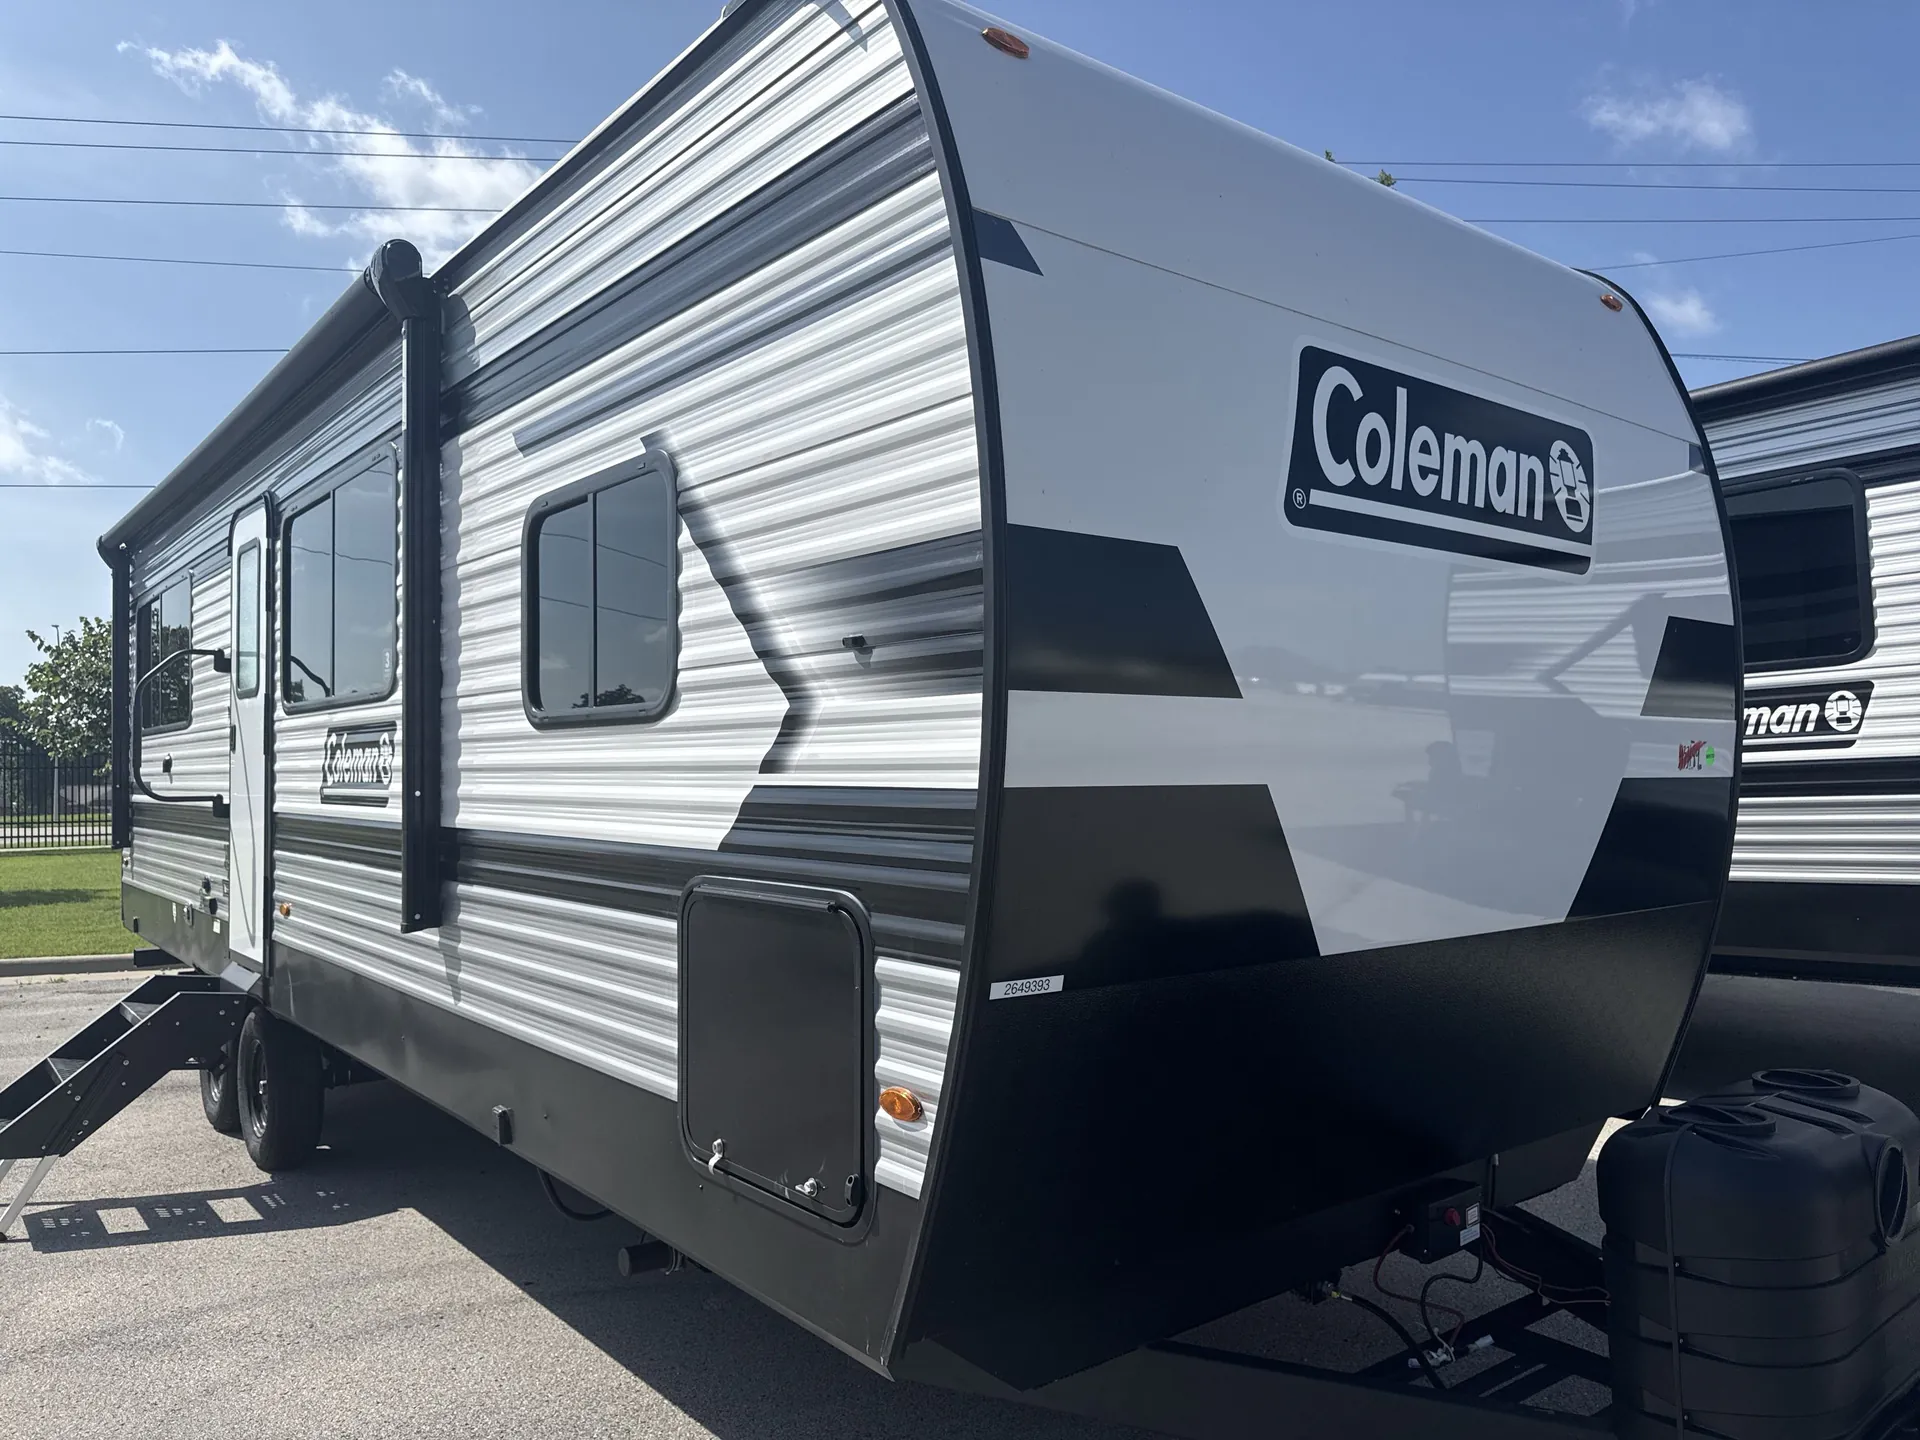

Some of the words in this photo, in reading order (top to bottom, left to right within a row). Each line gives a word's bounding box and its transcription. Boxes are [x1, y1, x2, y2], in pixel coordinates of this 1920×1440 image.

[1312, 365, 1545, 521] Coleman
[325, 732, 379, 787] Coleman
[1003, 978, 1051, 996] 2649393
